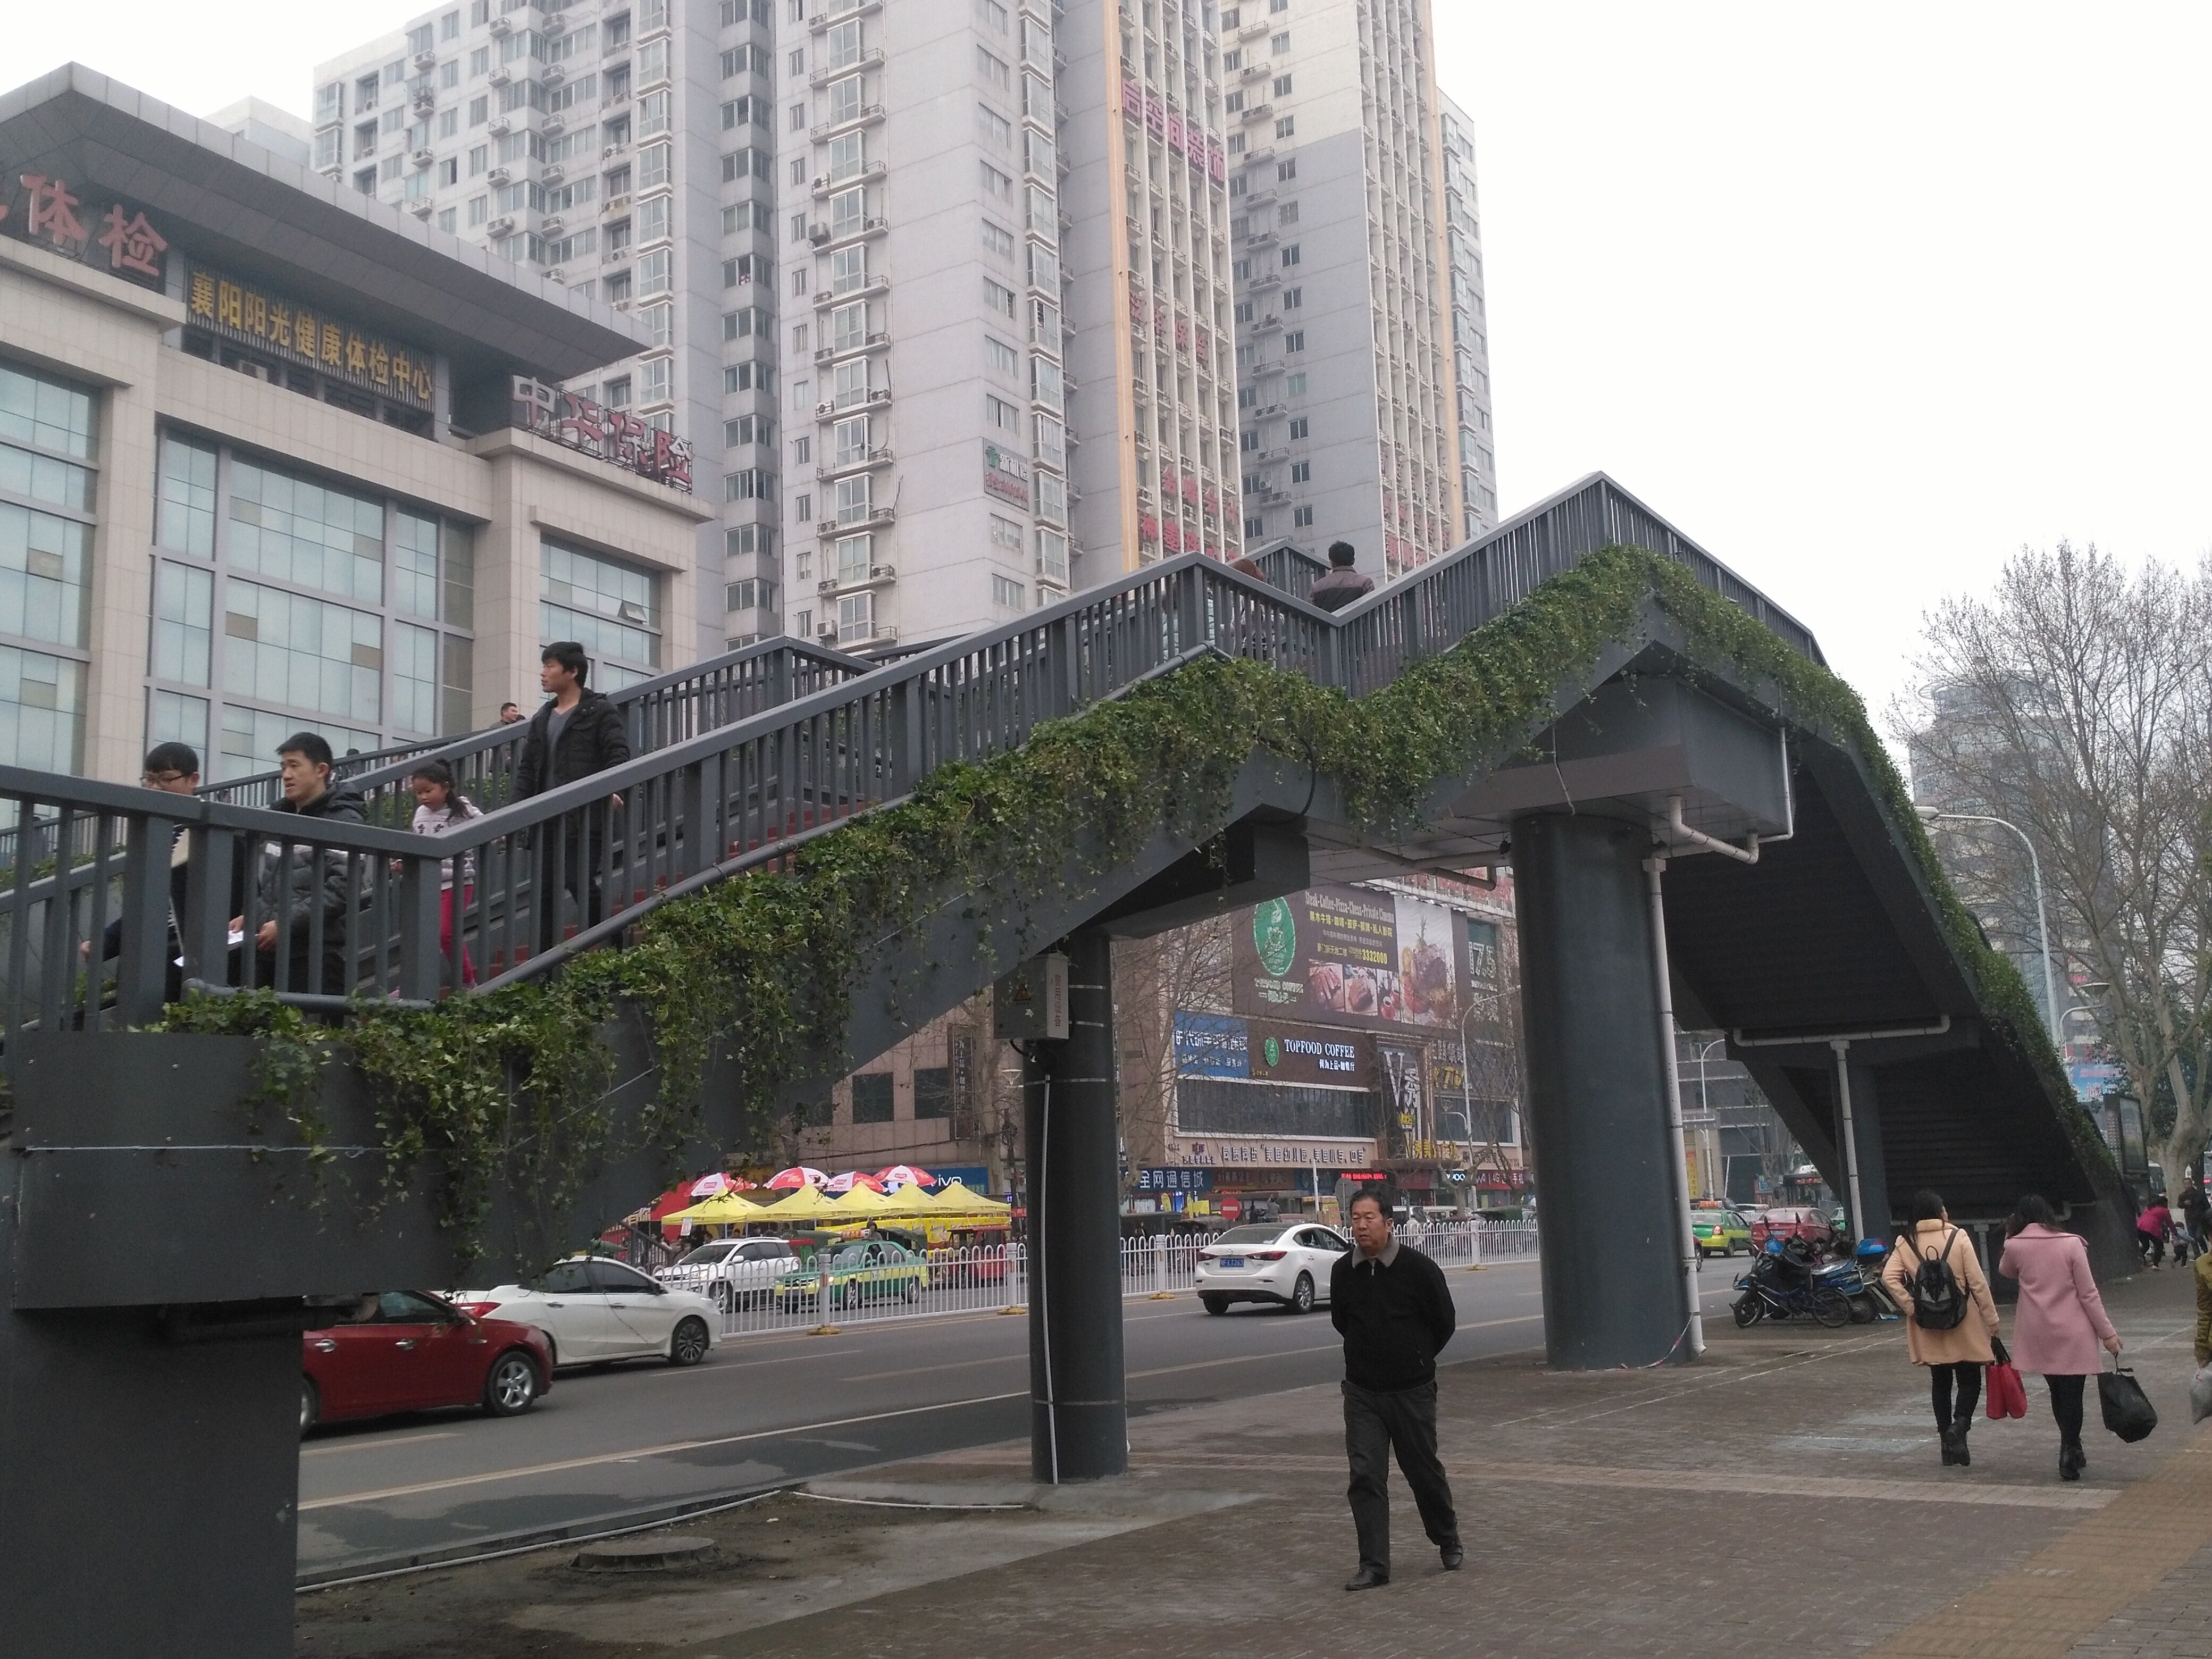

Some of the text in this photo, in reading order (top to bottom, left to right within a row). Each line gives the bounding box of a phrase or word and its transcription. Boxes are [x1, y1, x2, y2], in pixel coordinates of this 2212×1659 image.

[0, 174, 168, 276] 体检
[190, 270, 433, 401] 襄阳阳光健康体检中心
[512, 374, 696, 484] 中华保险
[1362, 949, 1388, 965] 3332000
[1284, 1039, 1355, 1059] TOPFOOD COFFEE
[932, 1174, 962, 1187] ivo
[1140, 1170, 1204, 1188] 全网通信城
